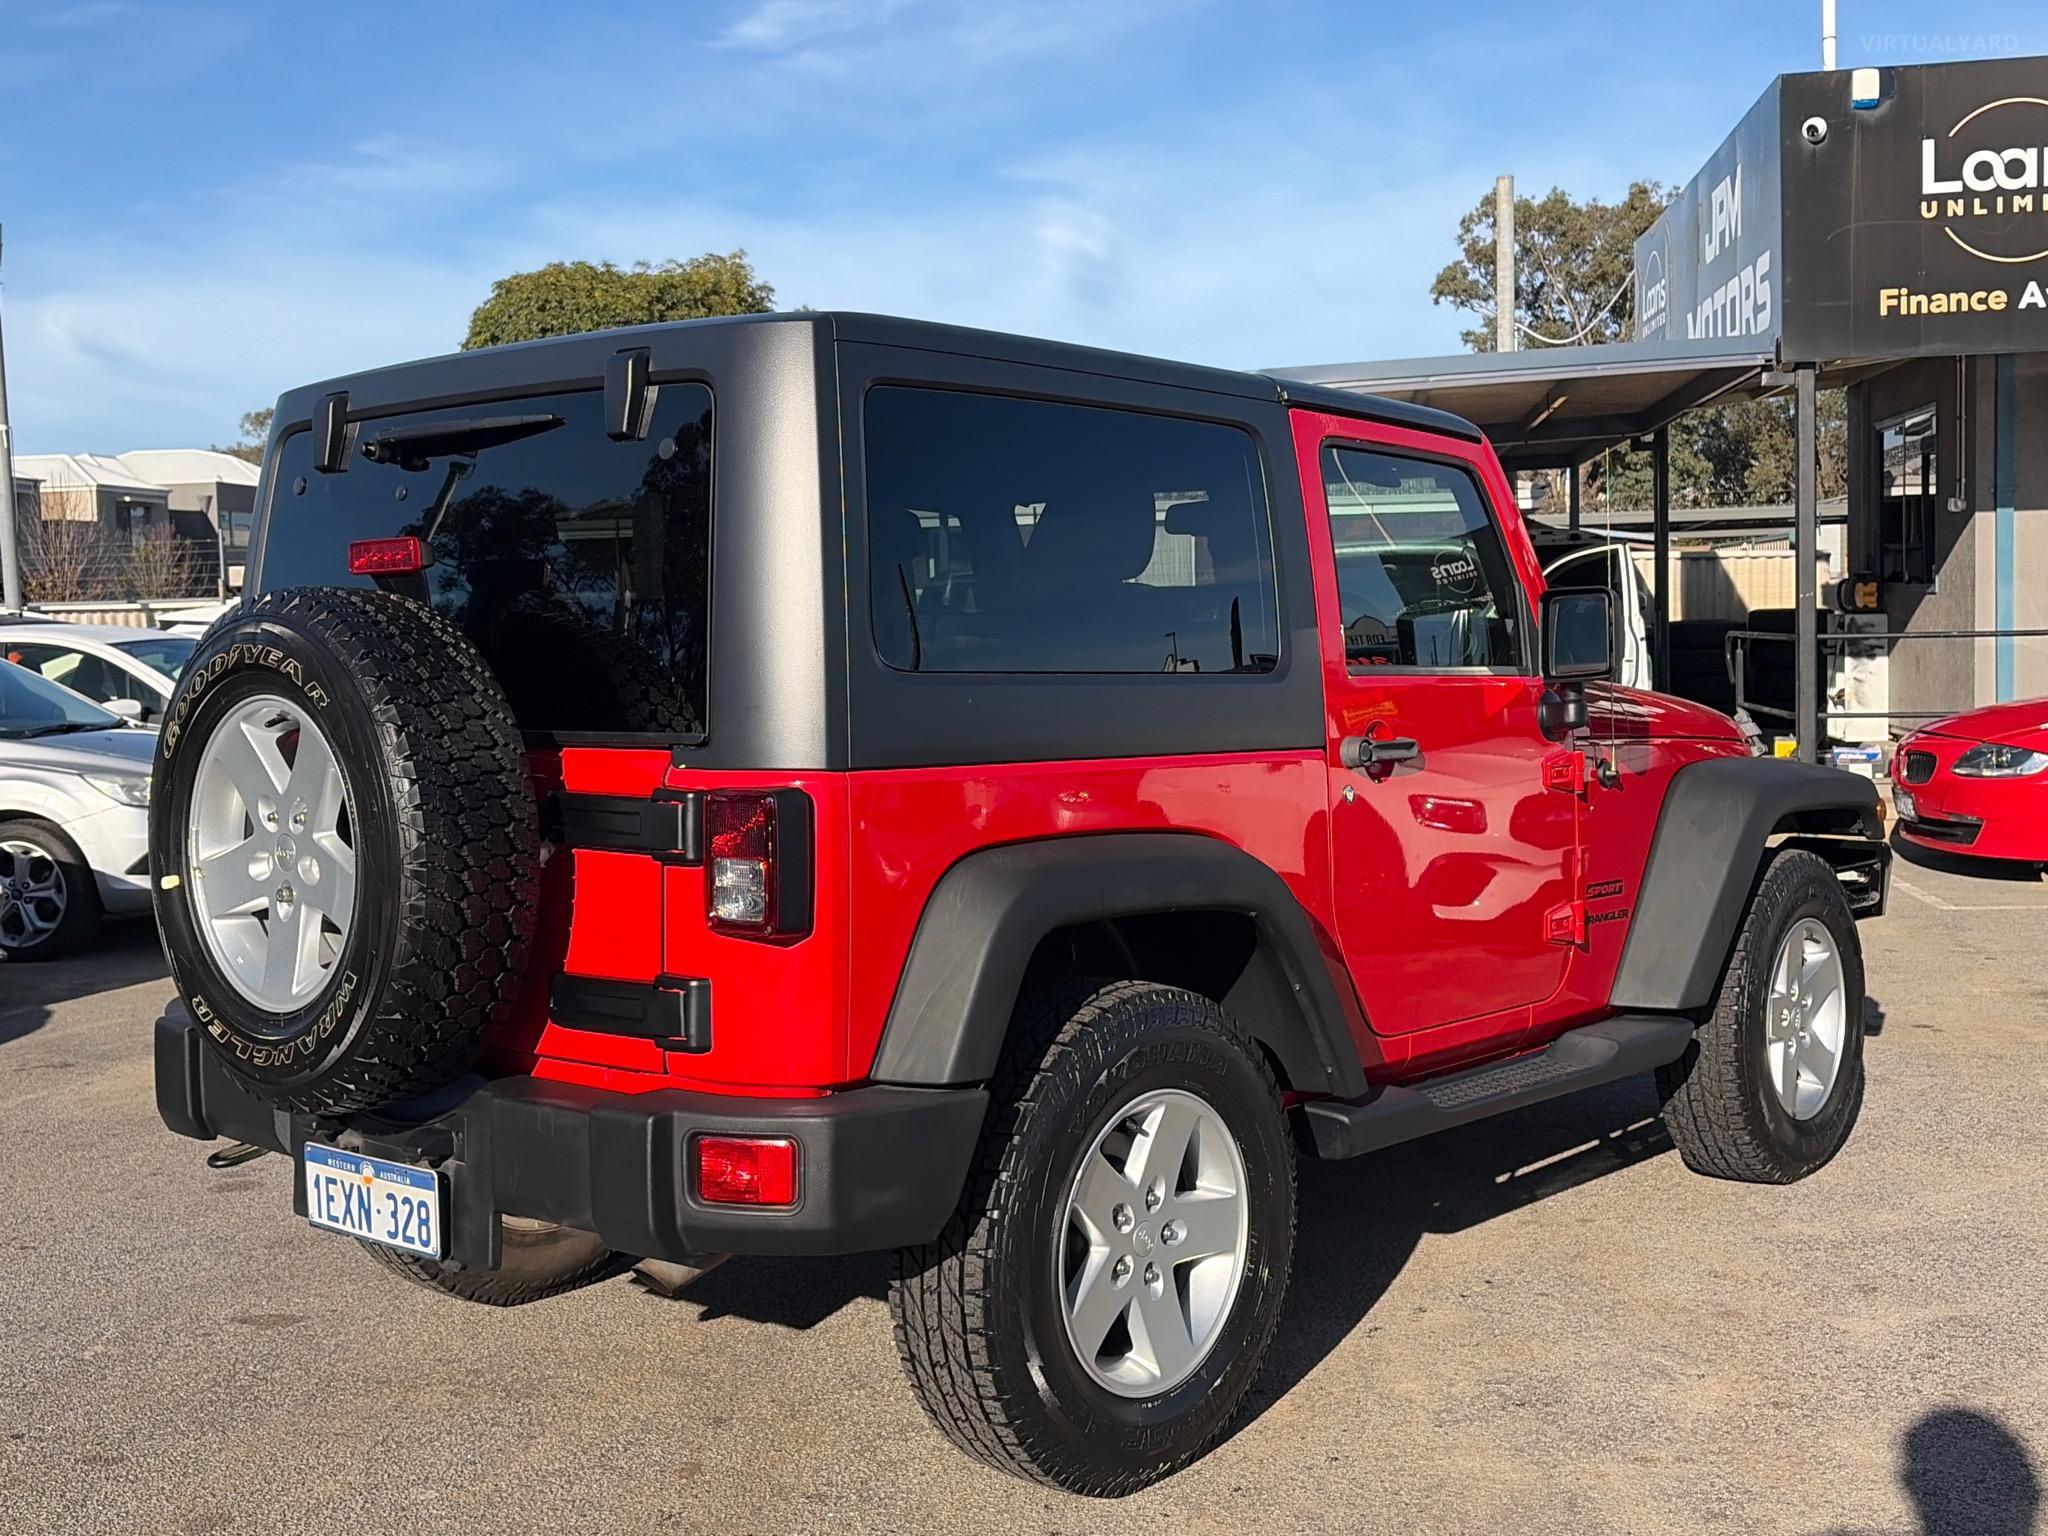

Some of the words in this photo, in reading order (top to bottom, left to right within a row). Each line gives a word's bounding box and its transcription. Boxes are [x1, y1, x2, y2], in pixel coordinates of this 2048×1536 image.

[1921, 138, 2048, 195] Loa
[1704, 163, 1742, 264] JPM
[1642, 278, 1666, 322] Loans
[1686, 249, 1771, 339] MOTORS
[1879, 287, 2008, 317] Finance
[2017, 280, 2048, 310] A
[163, 643, 331, 760] GOODYEAR
[1588, 883, 1621, 897] SPORT
[1585, 908, 1629, 926] RANGLER
[191, 972, 359, 1067] WRANGLER
[327, 1158, 356, 1173] WESTERN
[379, 1171, 411, 1185] AUSTRALIA
